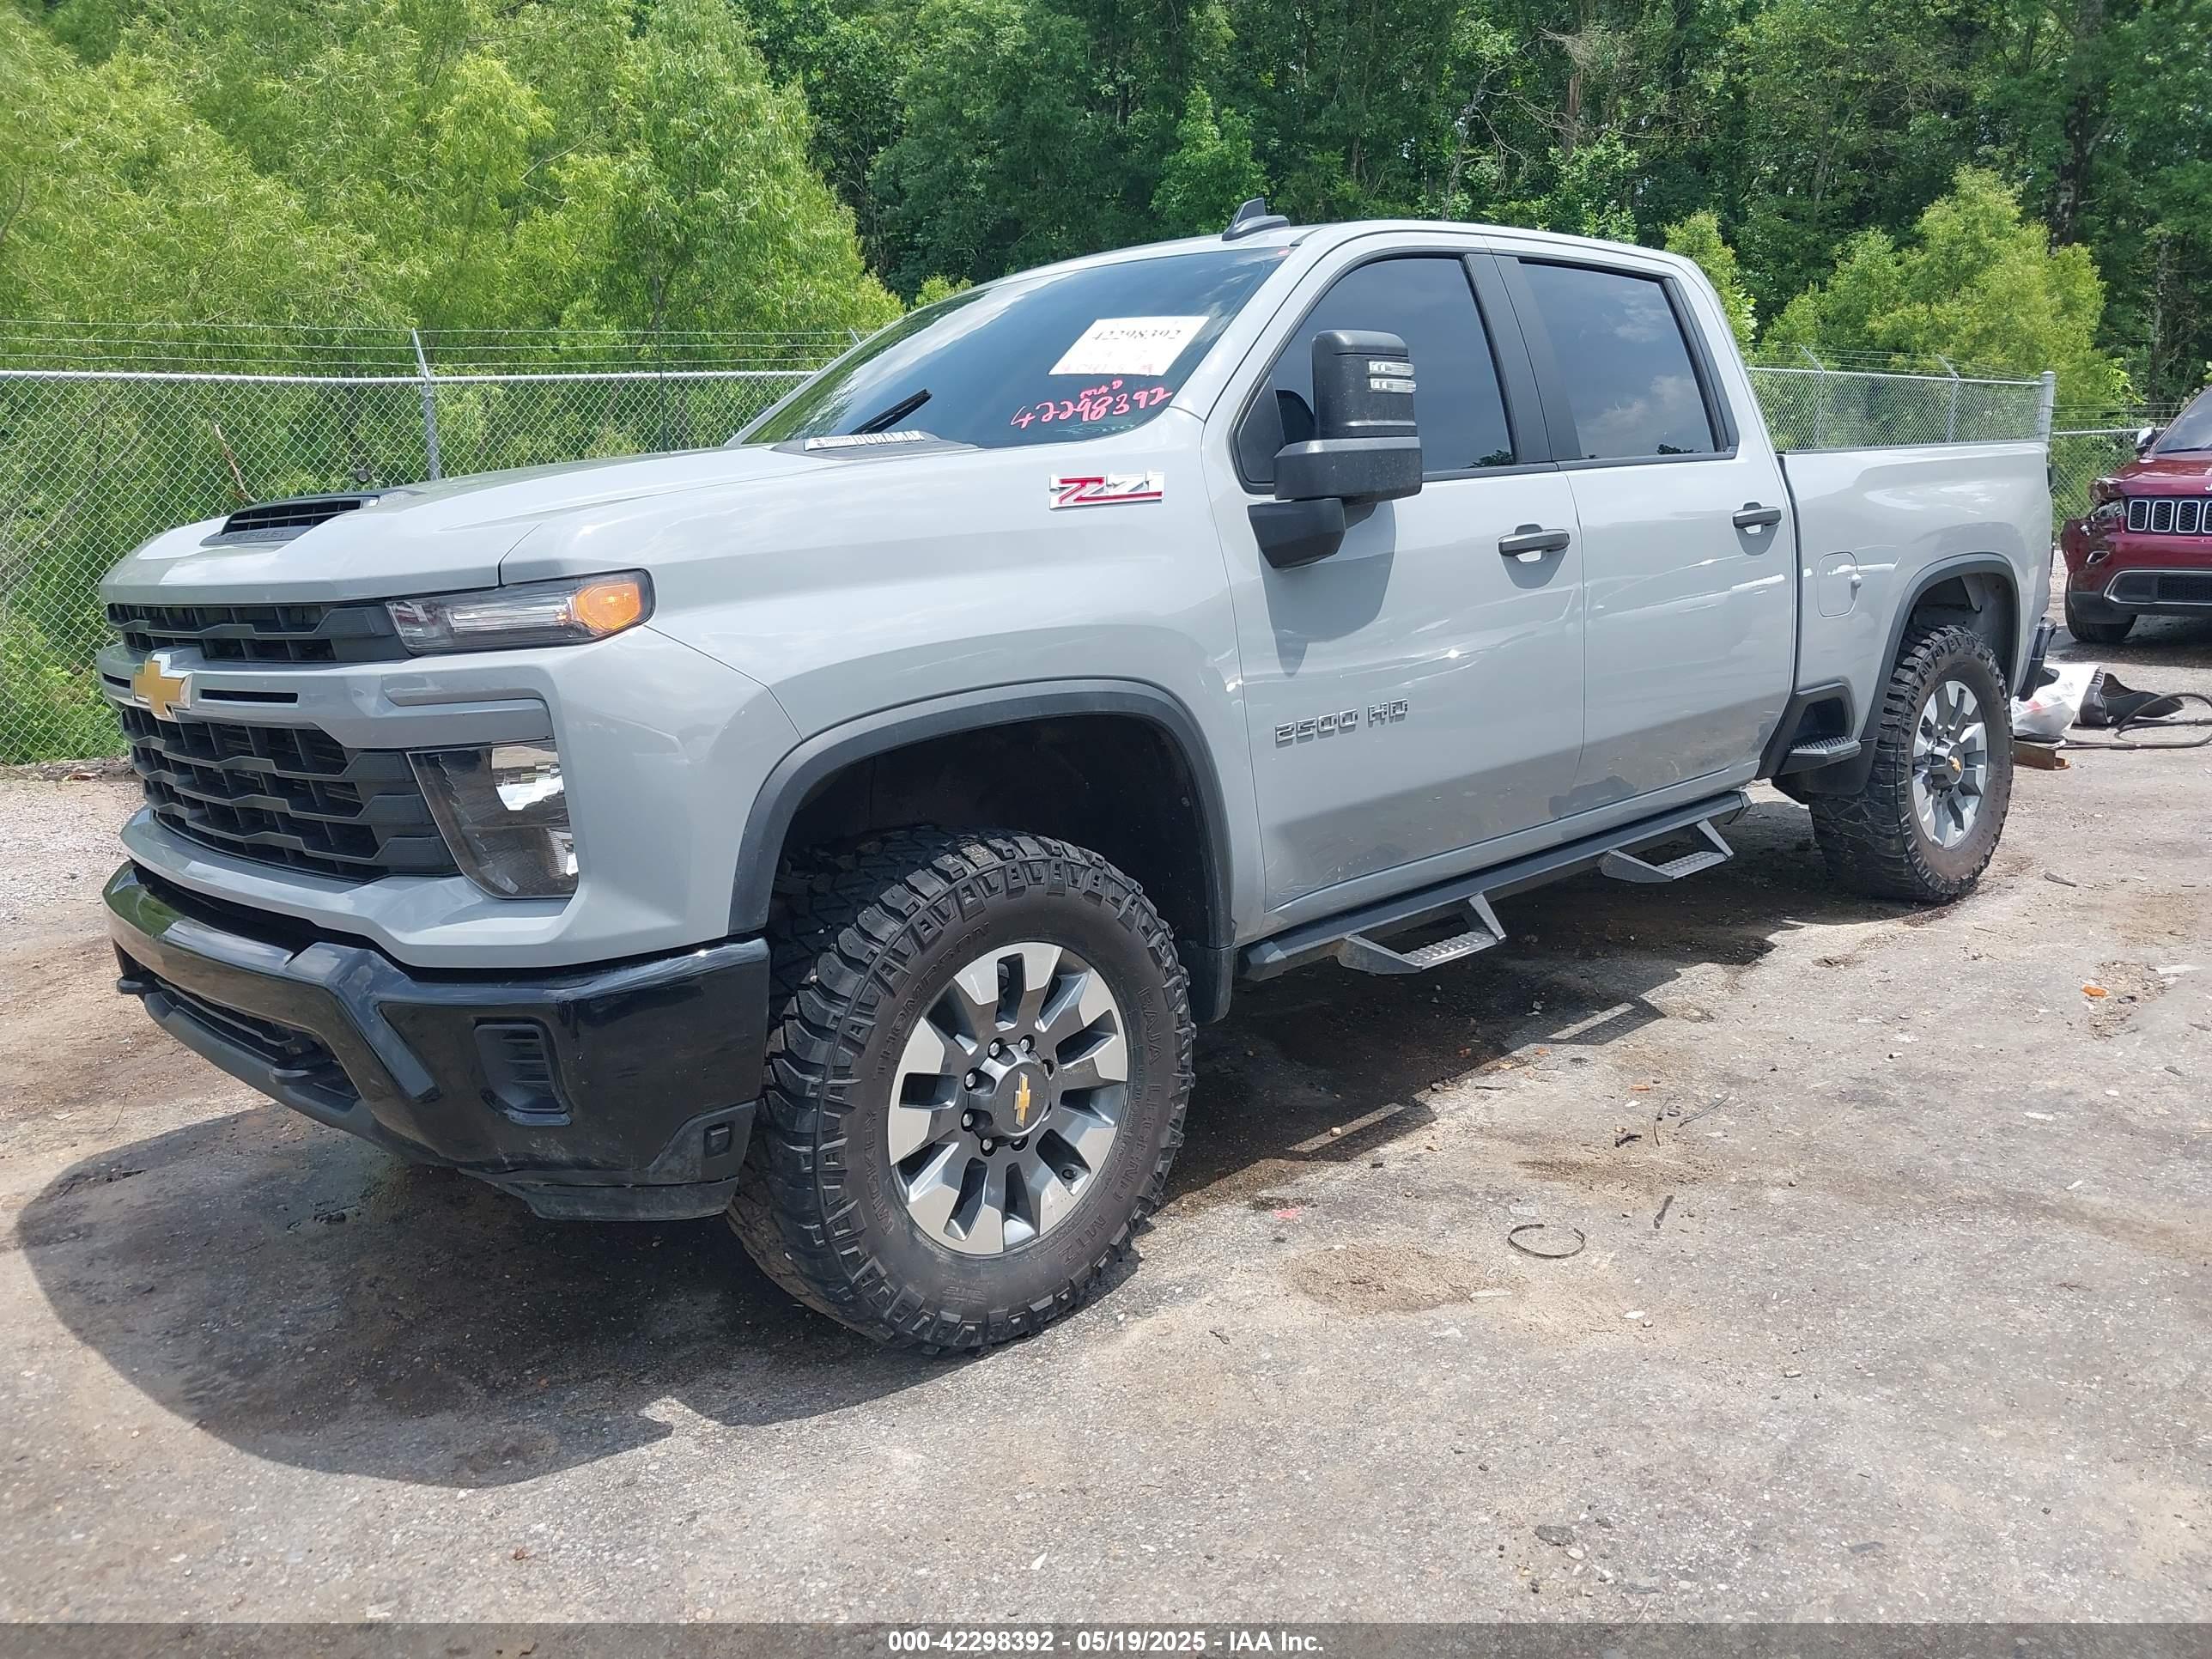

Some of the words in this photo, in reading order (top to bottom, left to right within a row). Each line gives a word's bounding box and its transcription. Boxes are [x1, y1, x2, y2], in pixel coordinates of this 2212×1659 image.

[1009, 386, 1174, 429] 42298392
[852, 430, 926, 446] DURAMAX
[1049, 471, 1165, 511] Z71
[1274, 708, 1359, 744] 2500
[1367, 698, 1409, 726] HD
